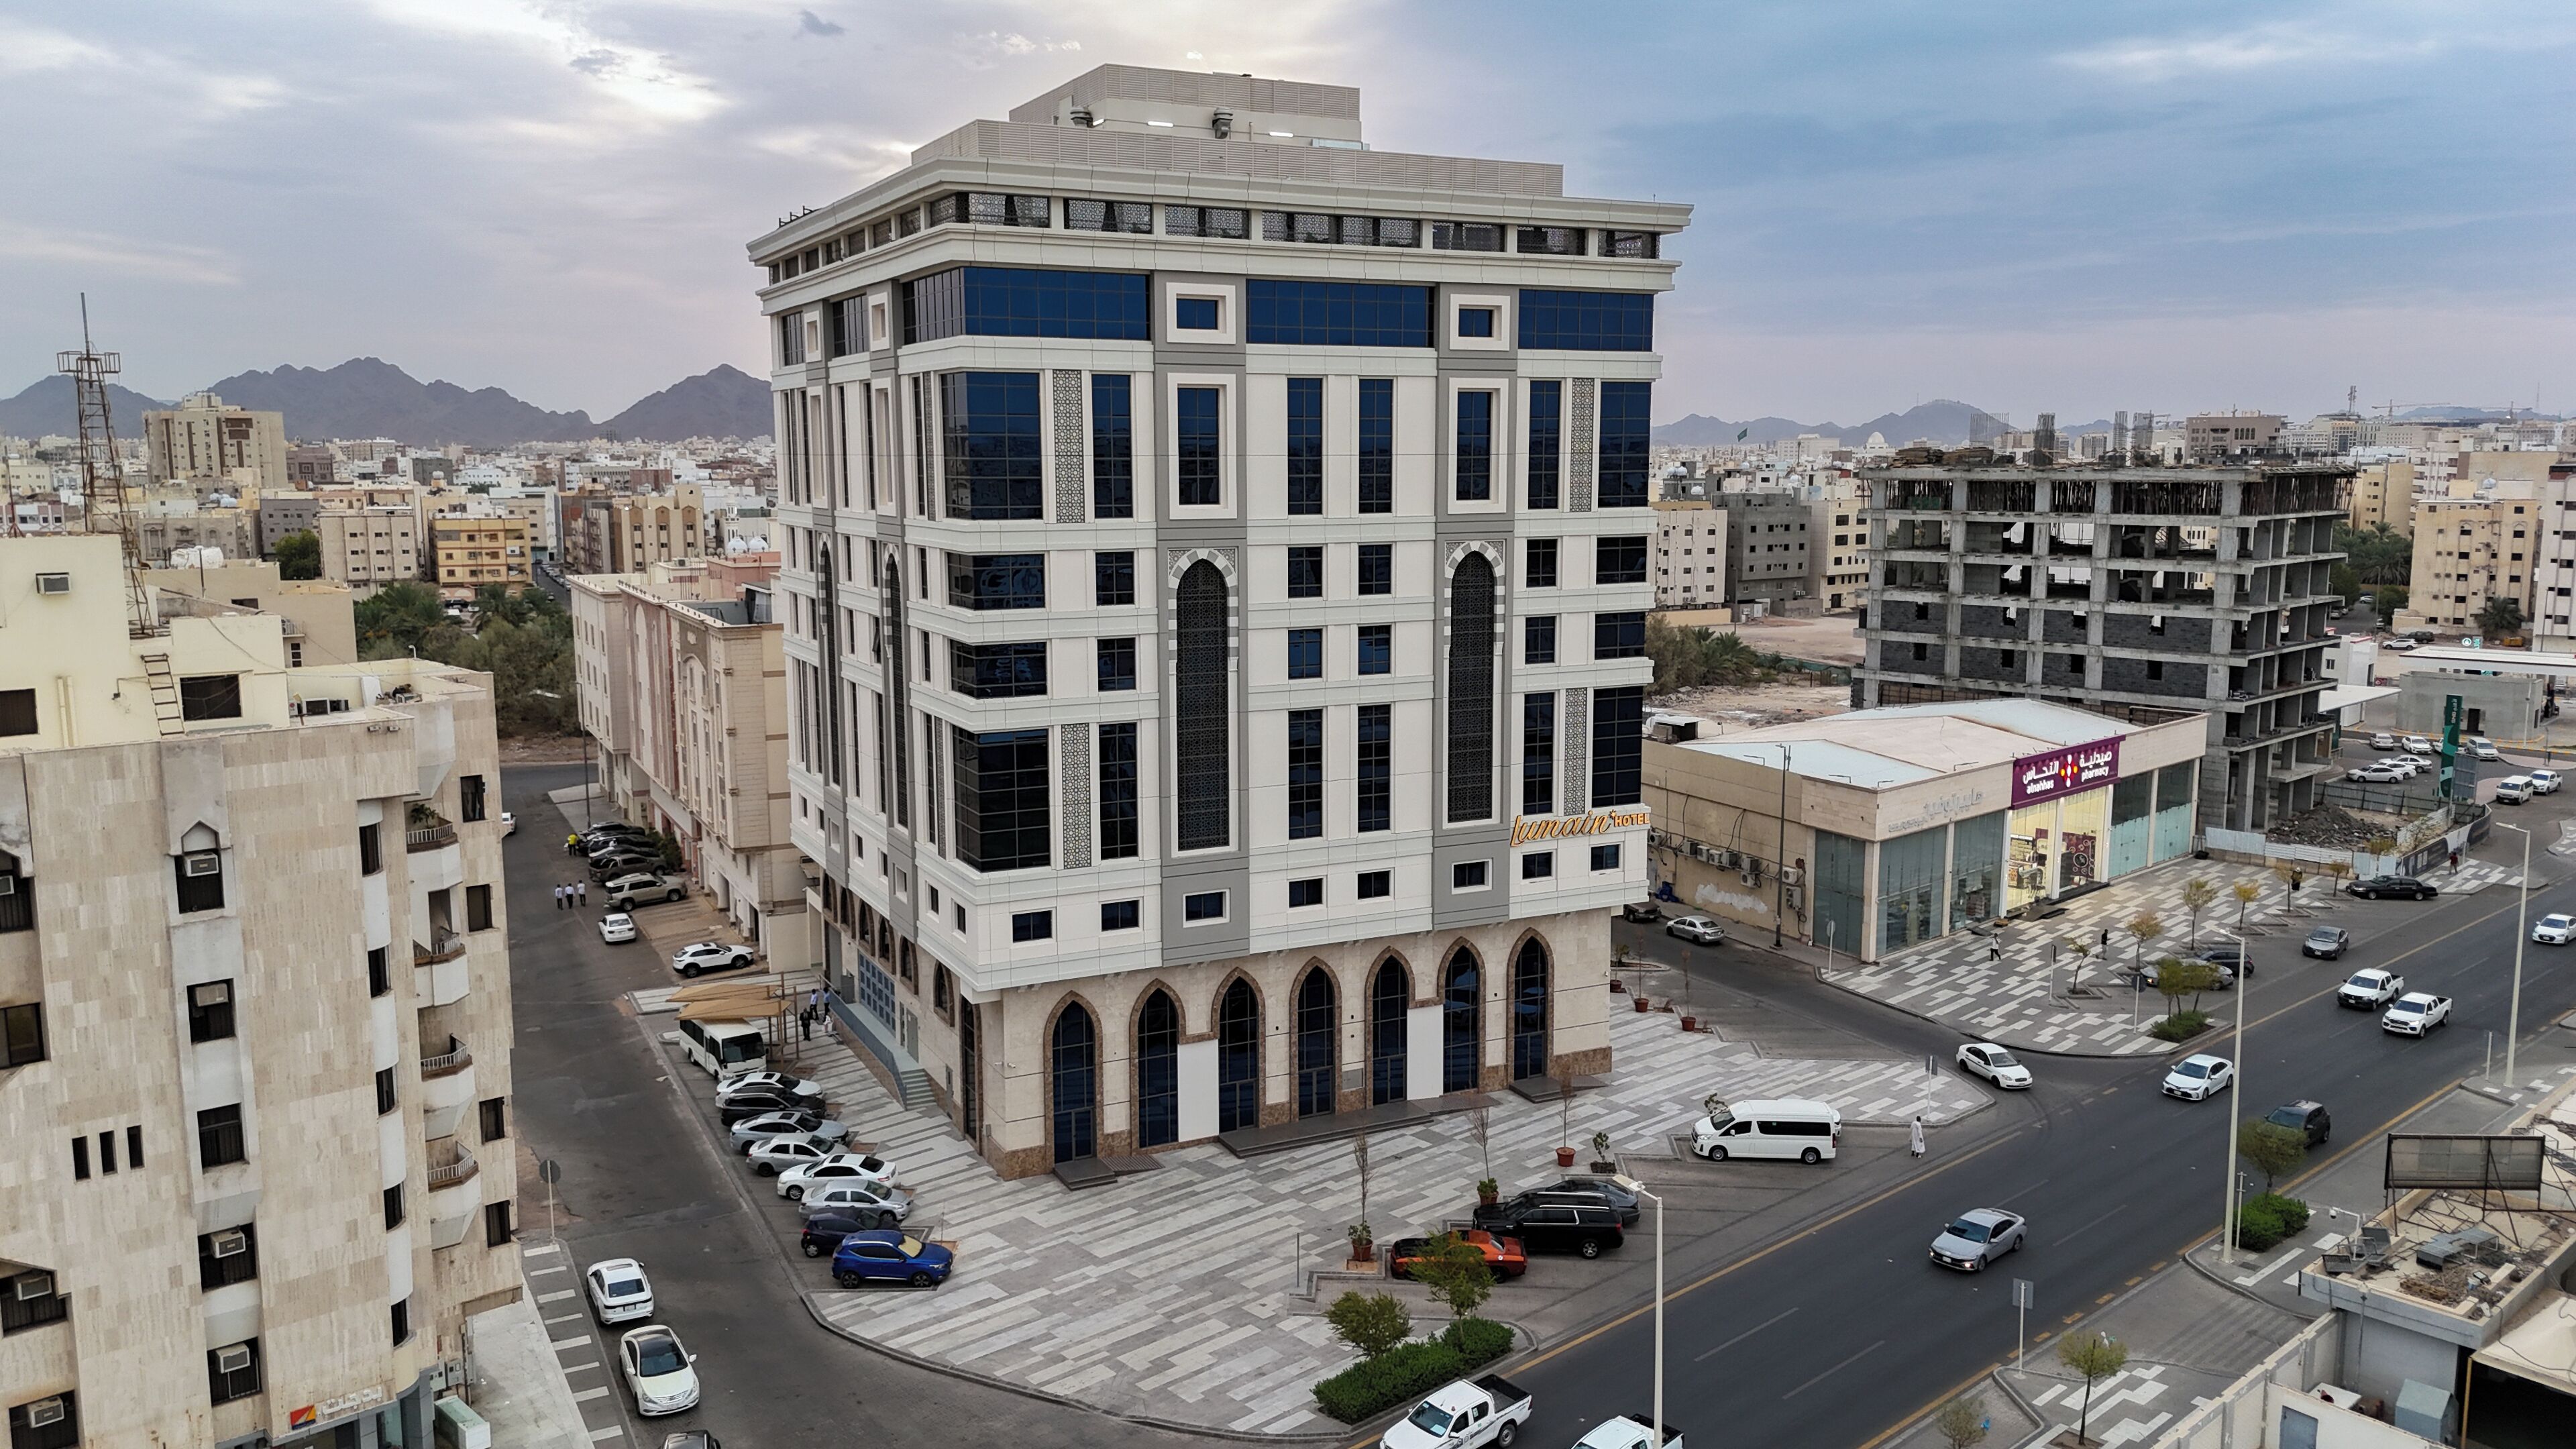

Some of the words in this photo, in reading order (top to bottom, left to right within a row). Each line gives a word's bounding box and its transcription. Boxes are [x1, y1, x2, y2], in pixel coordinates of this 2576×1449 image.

[2023, 761, 2059, 785] النحاس
[2079, 751, 2112, 769] صيدلية
[2027, 780, 2055, 794] alnahhas
[2081, 766, 2109, 783] pharmacy
[1510, 810, 1611, 847] Lumain
[1615, 812, 1650, 827] HOTEL
